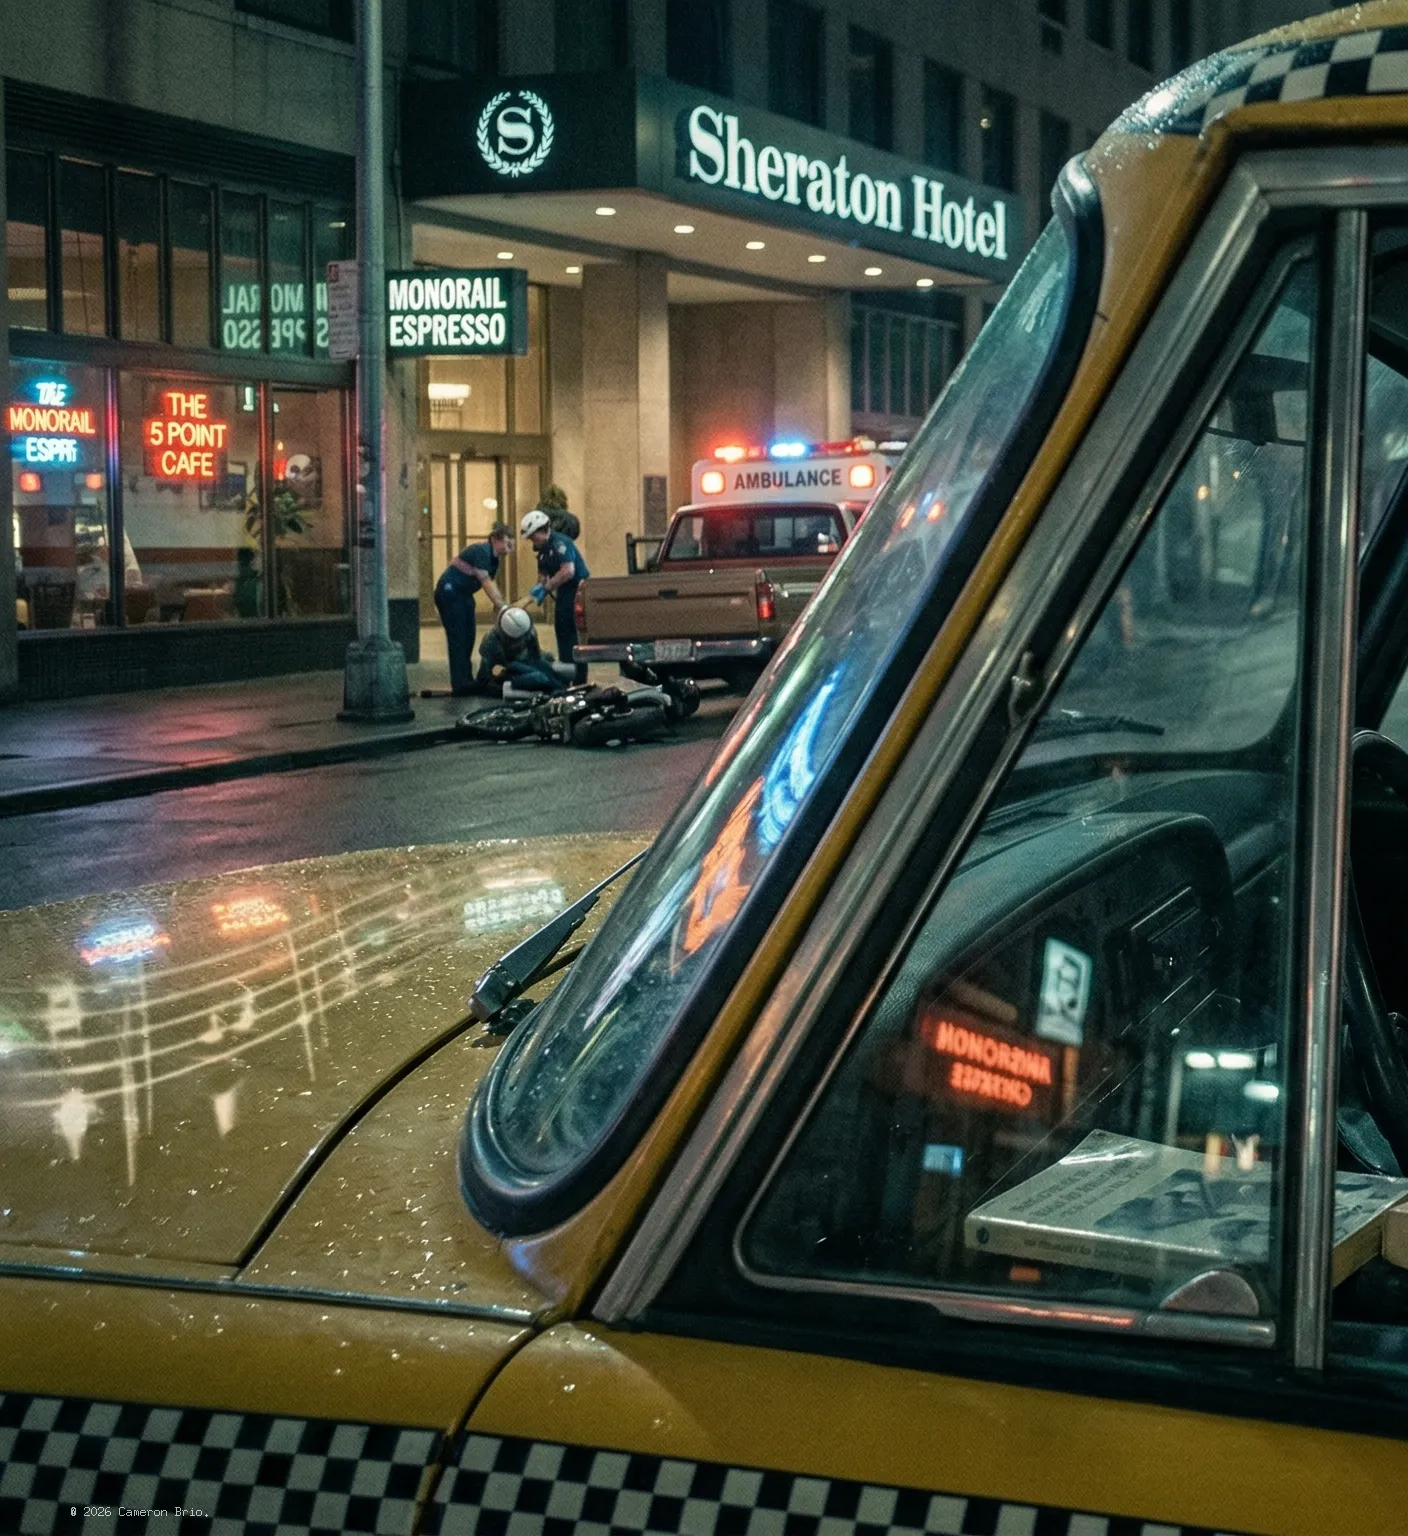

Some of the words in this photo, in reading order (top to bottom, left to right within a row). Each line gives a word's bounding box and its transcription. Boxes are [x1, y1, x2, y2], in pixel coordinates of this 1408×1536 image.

[496, 106, 536, 156] S
[688, 104, 903, 233] Sheraton
[911, 173, 1008, 261] Hotel
[388, 276, 507, 310] MONORAIL
[389, 313, 506, 347] ESPRESSO
[167, 392, 208, 419] THE
[9, 407, 96, 434] MONORAIL
[150, 421, 164, 446] 5
[168, 422, 227, 448] POINT
[161, 450, 214, 477] CAFE
[734, 468, 842, 491] AMBULANCE
